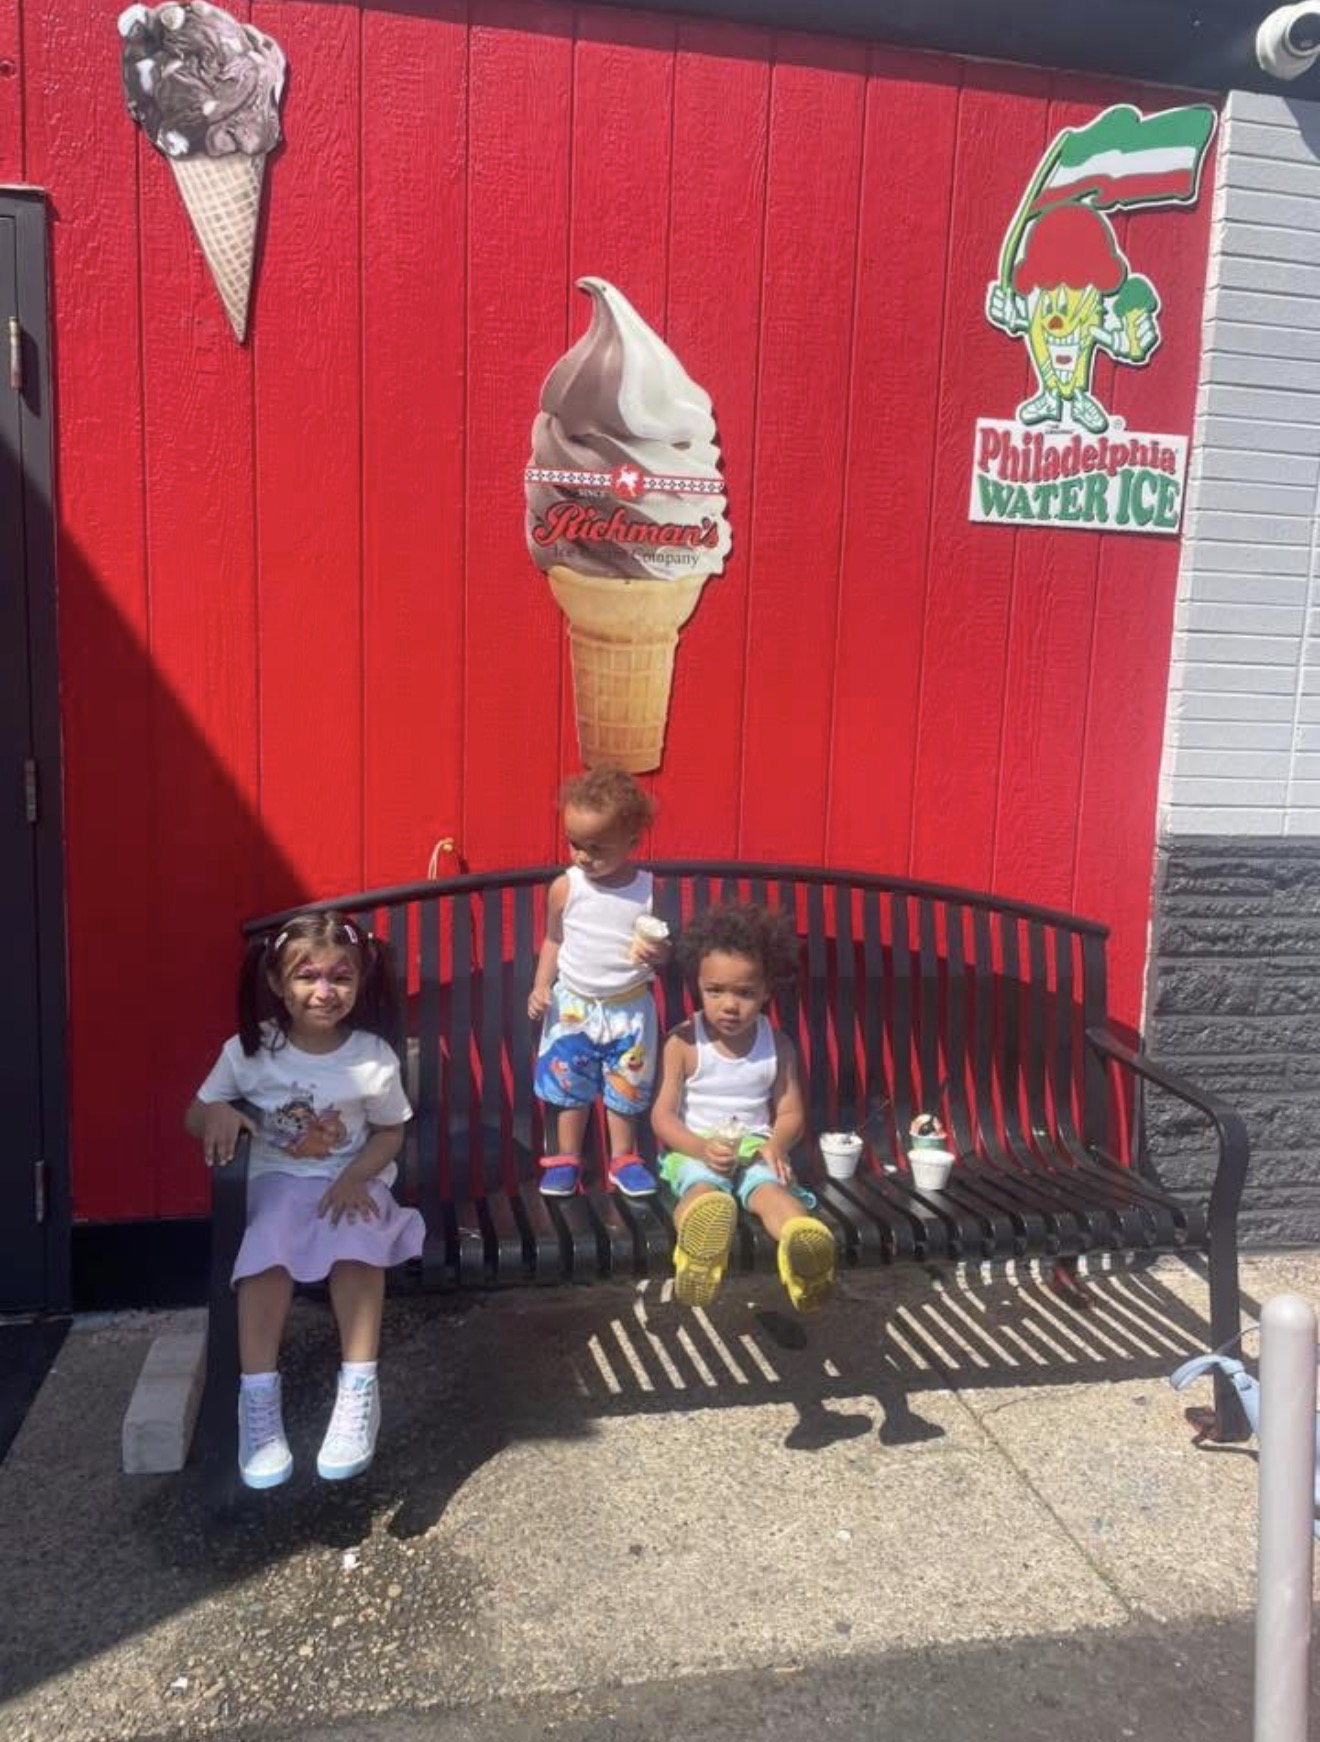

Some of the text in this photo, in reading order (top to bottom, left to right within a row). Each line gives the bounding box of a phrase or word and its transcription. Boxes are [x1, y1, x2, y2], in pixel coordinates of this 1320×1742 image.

[977, 427, 1176, 484] Philadelphia
[532, 499, 719, 548] Richman's
[977, 468, 1180, 528] WATER ICE
[554, 543, 573, 558] Ice
[631, 548, 700, 569] Company
